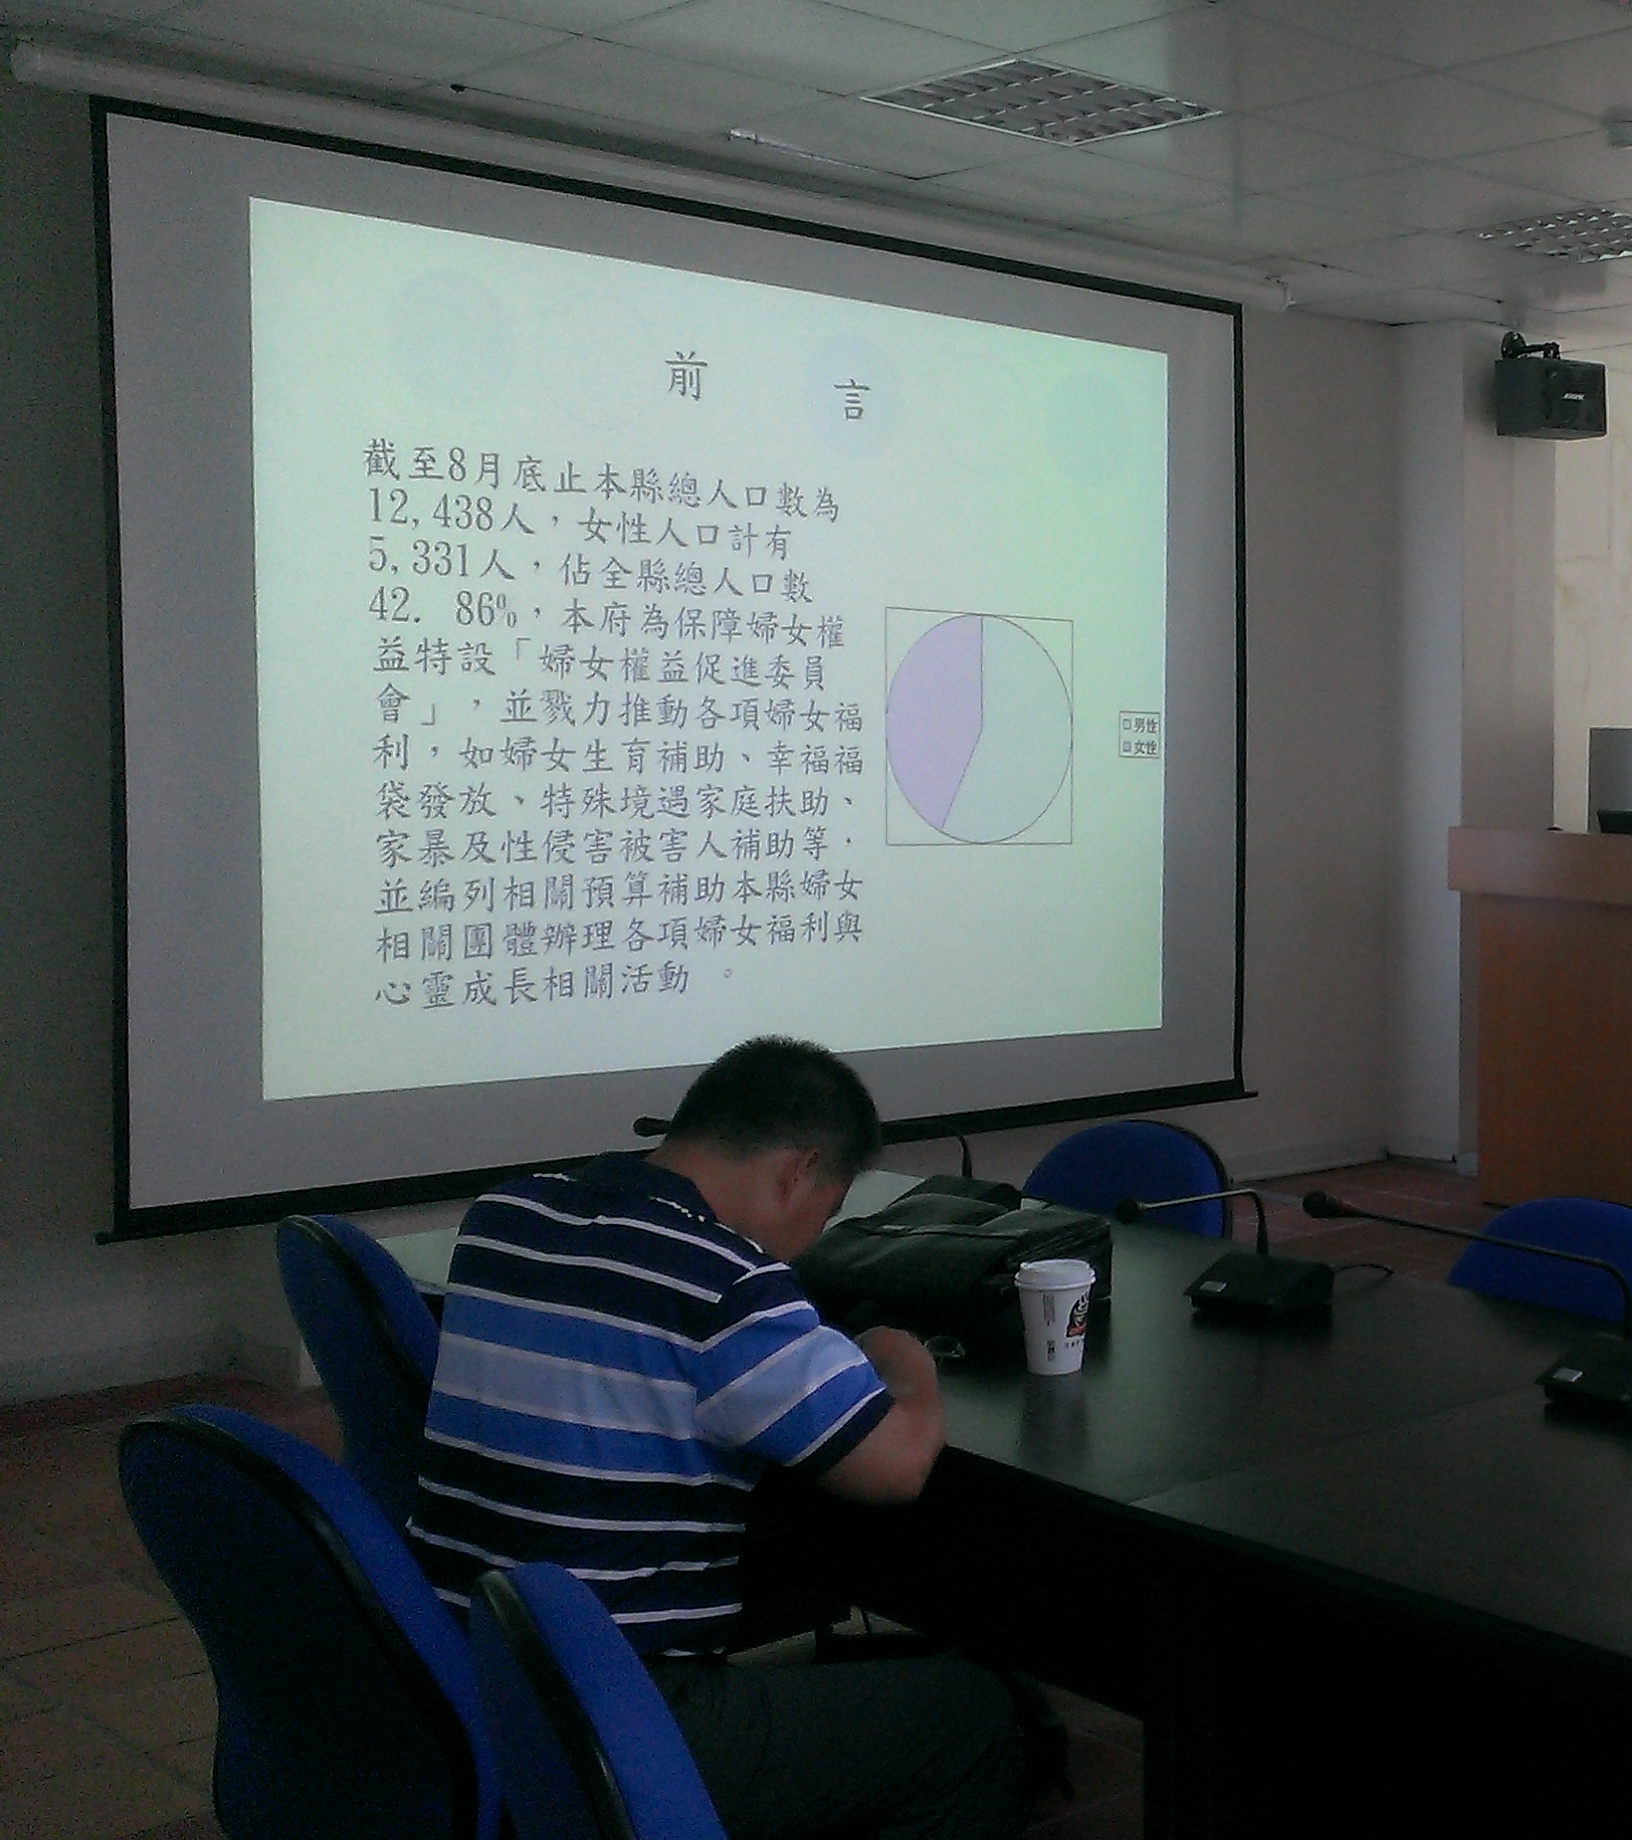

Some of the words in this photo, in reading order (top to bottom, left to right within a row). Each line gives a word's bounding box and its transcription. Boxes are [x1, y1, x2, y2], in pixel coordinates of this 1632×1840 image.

[665, 351, 708, 401] 前
[834, 378, 871, 421] 言
[362, 438, 841, 523] 截至8月底止本縣總人口數為
[1134, 740, 1158, 756] 女性
